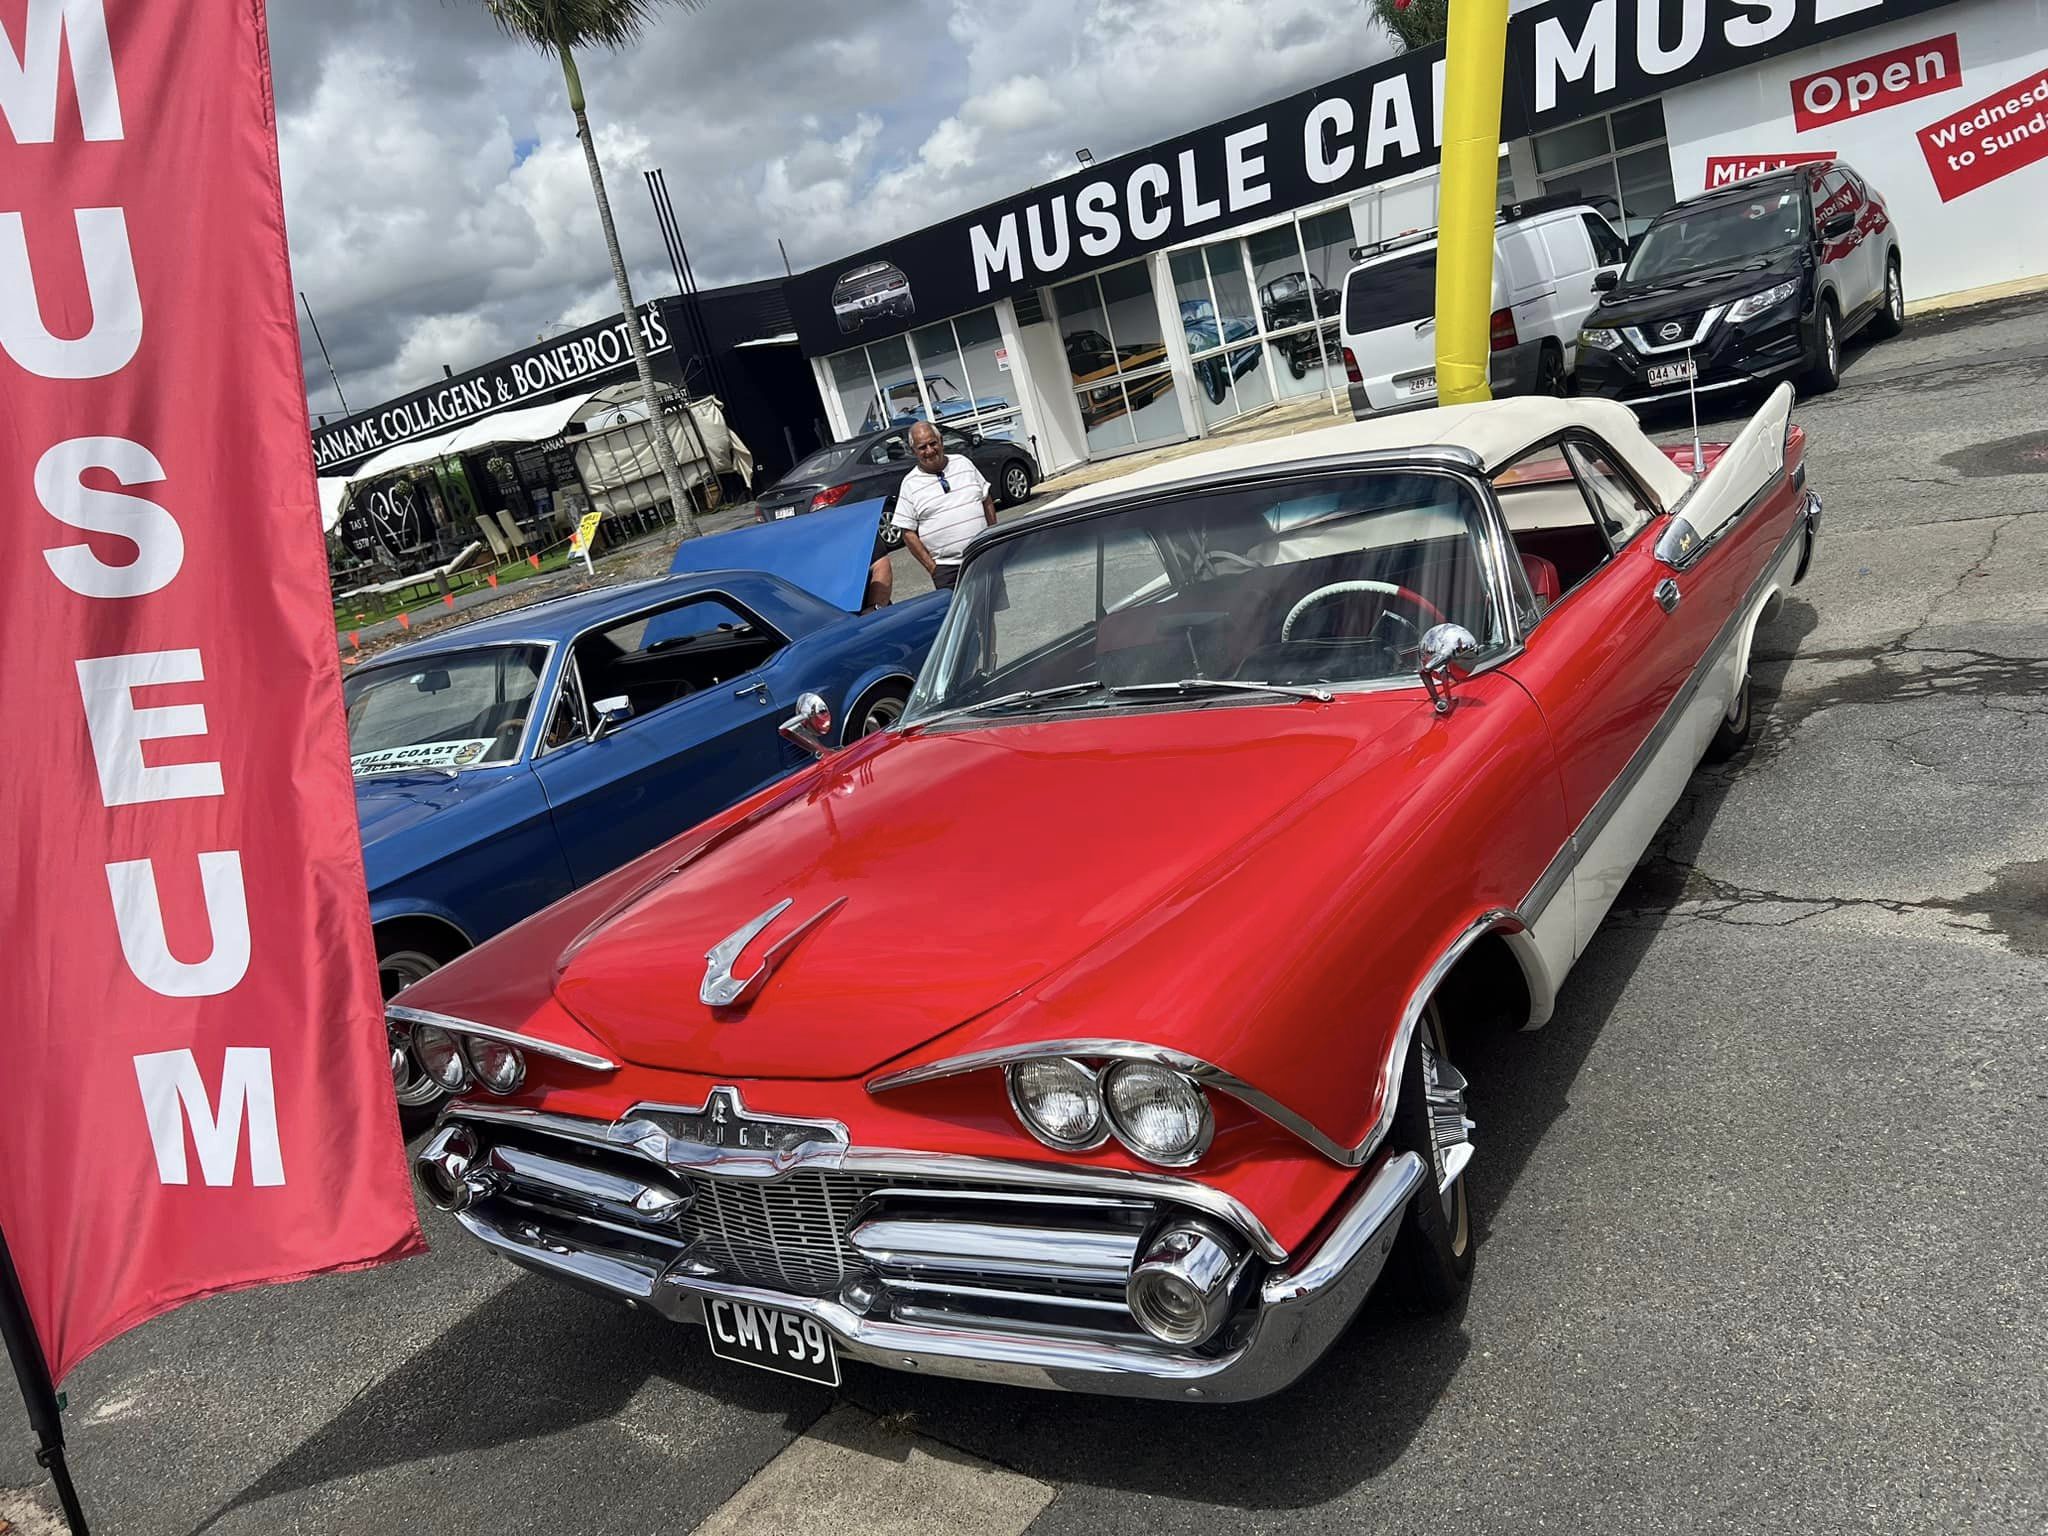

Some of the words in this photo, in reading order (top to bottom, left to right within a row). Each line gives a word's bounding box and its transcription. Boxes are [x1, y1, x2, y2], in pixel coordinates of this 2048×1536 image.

[1803, 50, 1946, 114] Open
[969, 122, 1272, 293] MUSCLE
[1304, 58, 1447, 184] CA
[1535, 0, 1883, 113] MUS
[1712, 160, 1786, 187] Mid
[1947, 151, 1976, 171] to
[1981, 112, 2048, 155] Sund
[312, 418, 383, 465] SANAME
[381, 376, 493, 441] COLLAGENS
[495, 377, 513, 402] &
[511, 311, 668, 396] BONEBROTHS
[0, 0, 286, 1187] MUSEUM
[396, 744, 460, 759] COAST
[711, 1299, 826, 1365] CMY59
